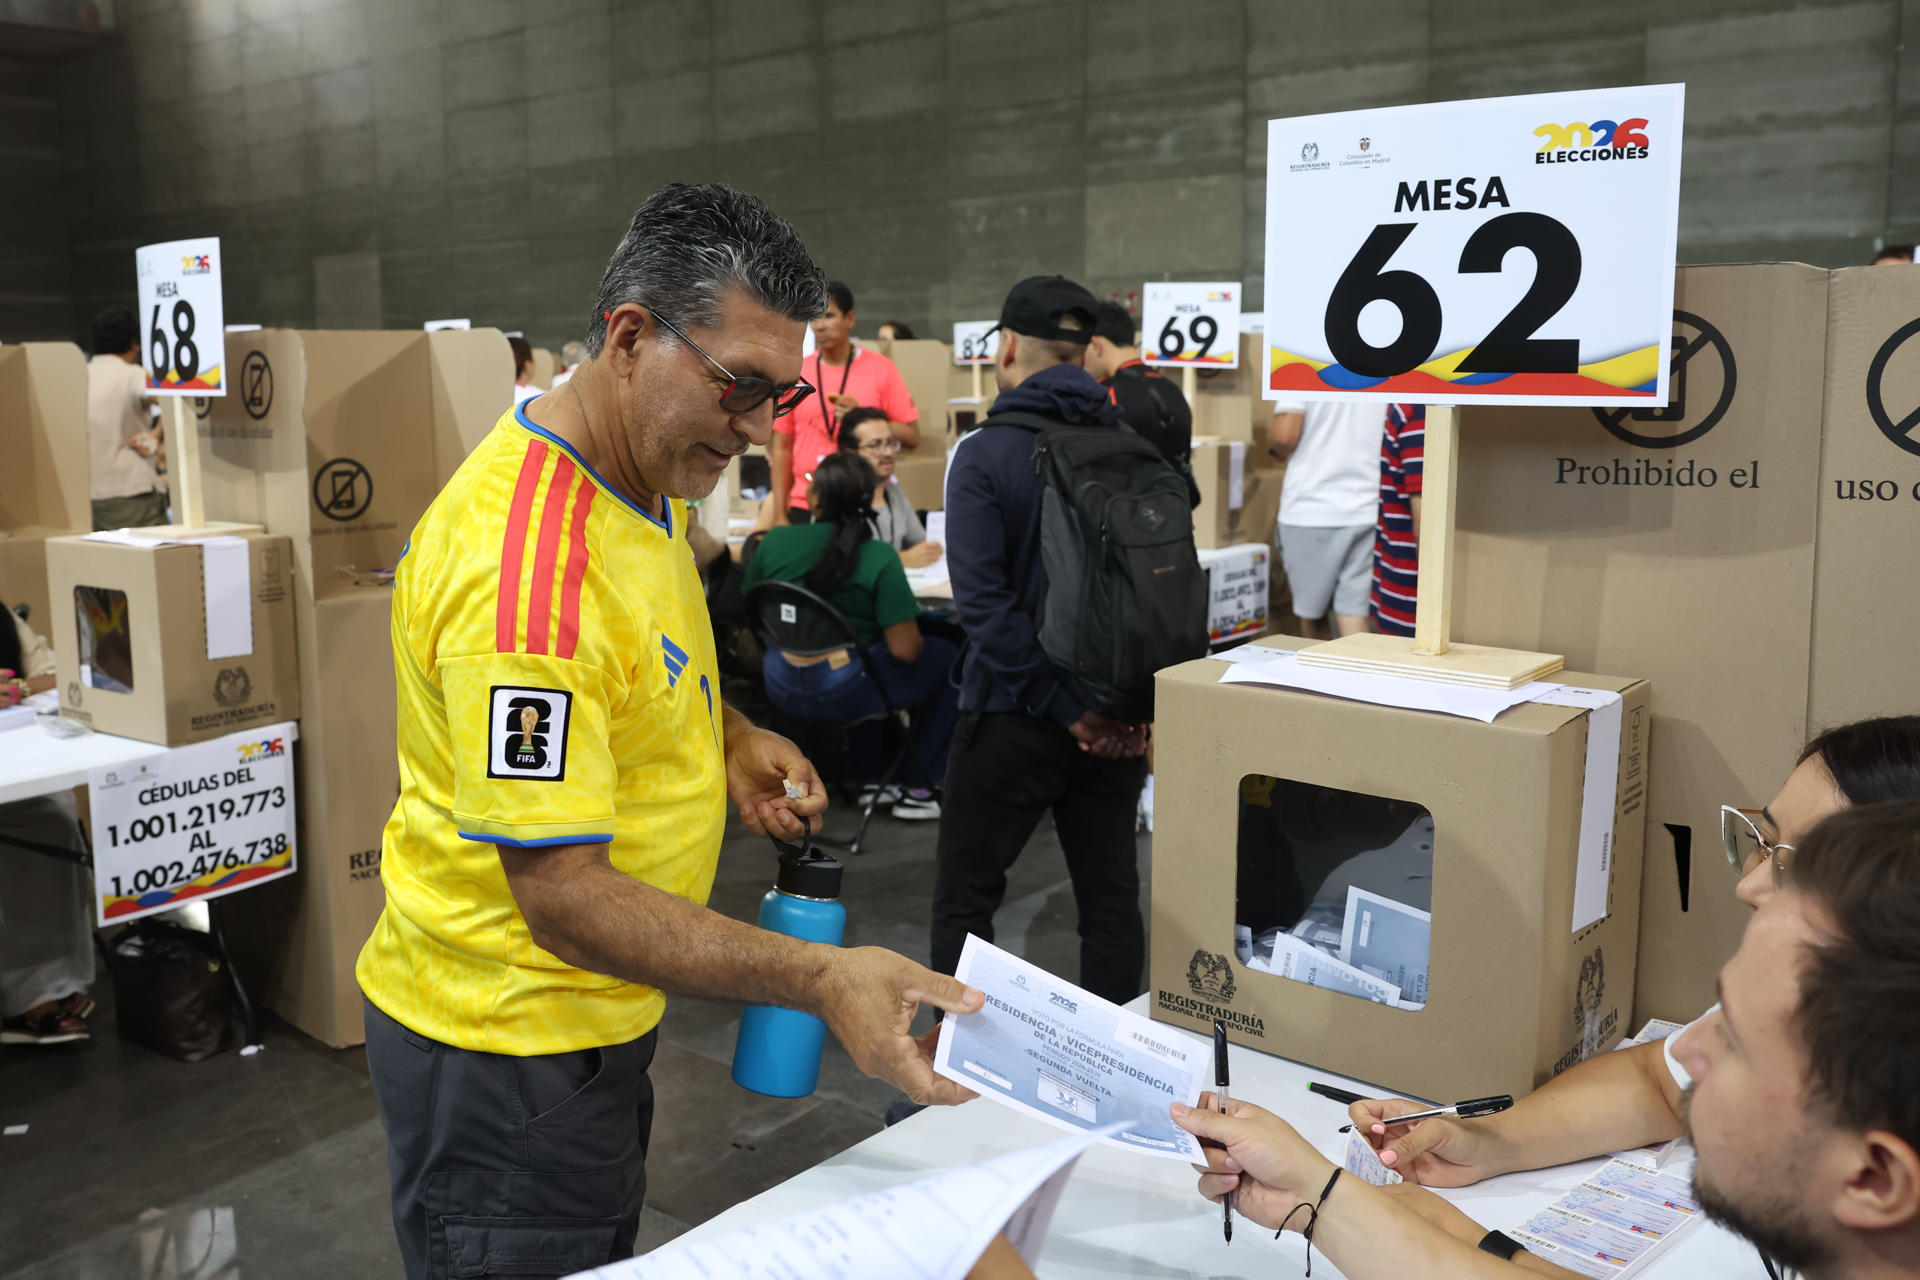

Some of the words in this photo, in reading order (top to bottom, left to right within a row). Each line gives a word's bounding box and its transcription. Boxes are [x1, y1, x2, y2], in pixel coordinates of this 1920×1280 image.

[1532, 118, 1649, 153] 2026
[1535, 147, 1649, 164] ELECCIONES
[1394, 175, 1511, 213] MESA
[156, 282, 178, 298] MESA
[1324, 211, 1582, 378] 62
[151, 299, 199, 382] 68
[1159, 315, 1218, 358] 69
[1554, 457, 1718, 488] Prohibido
[1728, 460, 1760, 488] el
[1834, 479, 1899, 501] uso
[237, 738, 285, 759] 2026
[516, 754, 536, 763] FIFA
[138, 774, 220, 806] CÉDULAS
[224, 767, 255, 787] DEL
[107, 786, 286, 848] 1.001.219.773
[188, 830, 216, 853] AL
[111, 833, 288, 898] 1.002.476.738
[1032, 1008, 1050, 1021] VOTO
[1051, 1016, 1066, 1028] POR
[1158, 990, 1265, 1031] REGISTRADURÍA
[1158, 1001, 1195, 1018] NACIONAL
[1196, 1012, 1212, 1023] DEL
[1244, 1026, 1265, 1039] CIVIL
[1034, 1030, 1046, 1041] DE
[1048, 1038, 1059, 1049] LA
[1066, 1035, 1175, 1096] VICEPRESIDENCIA
